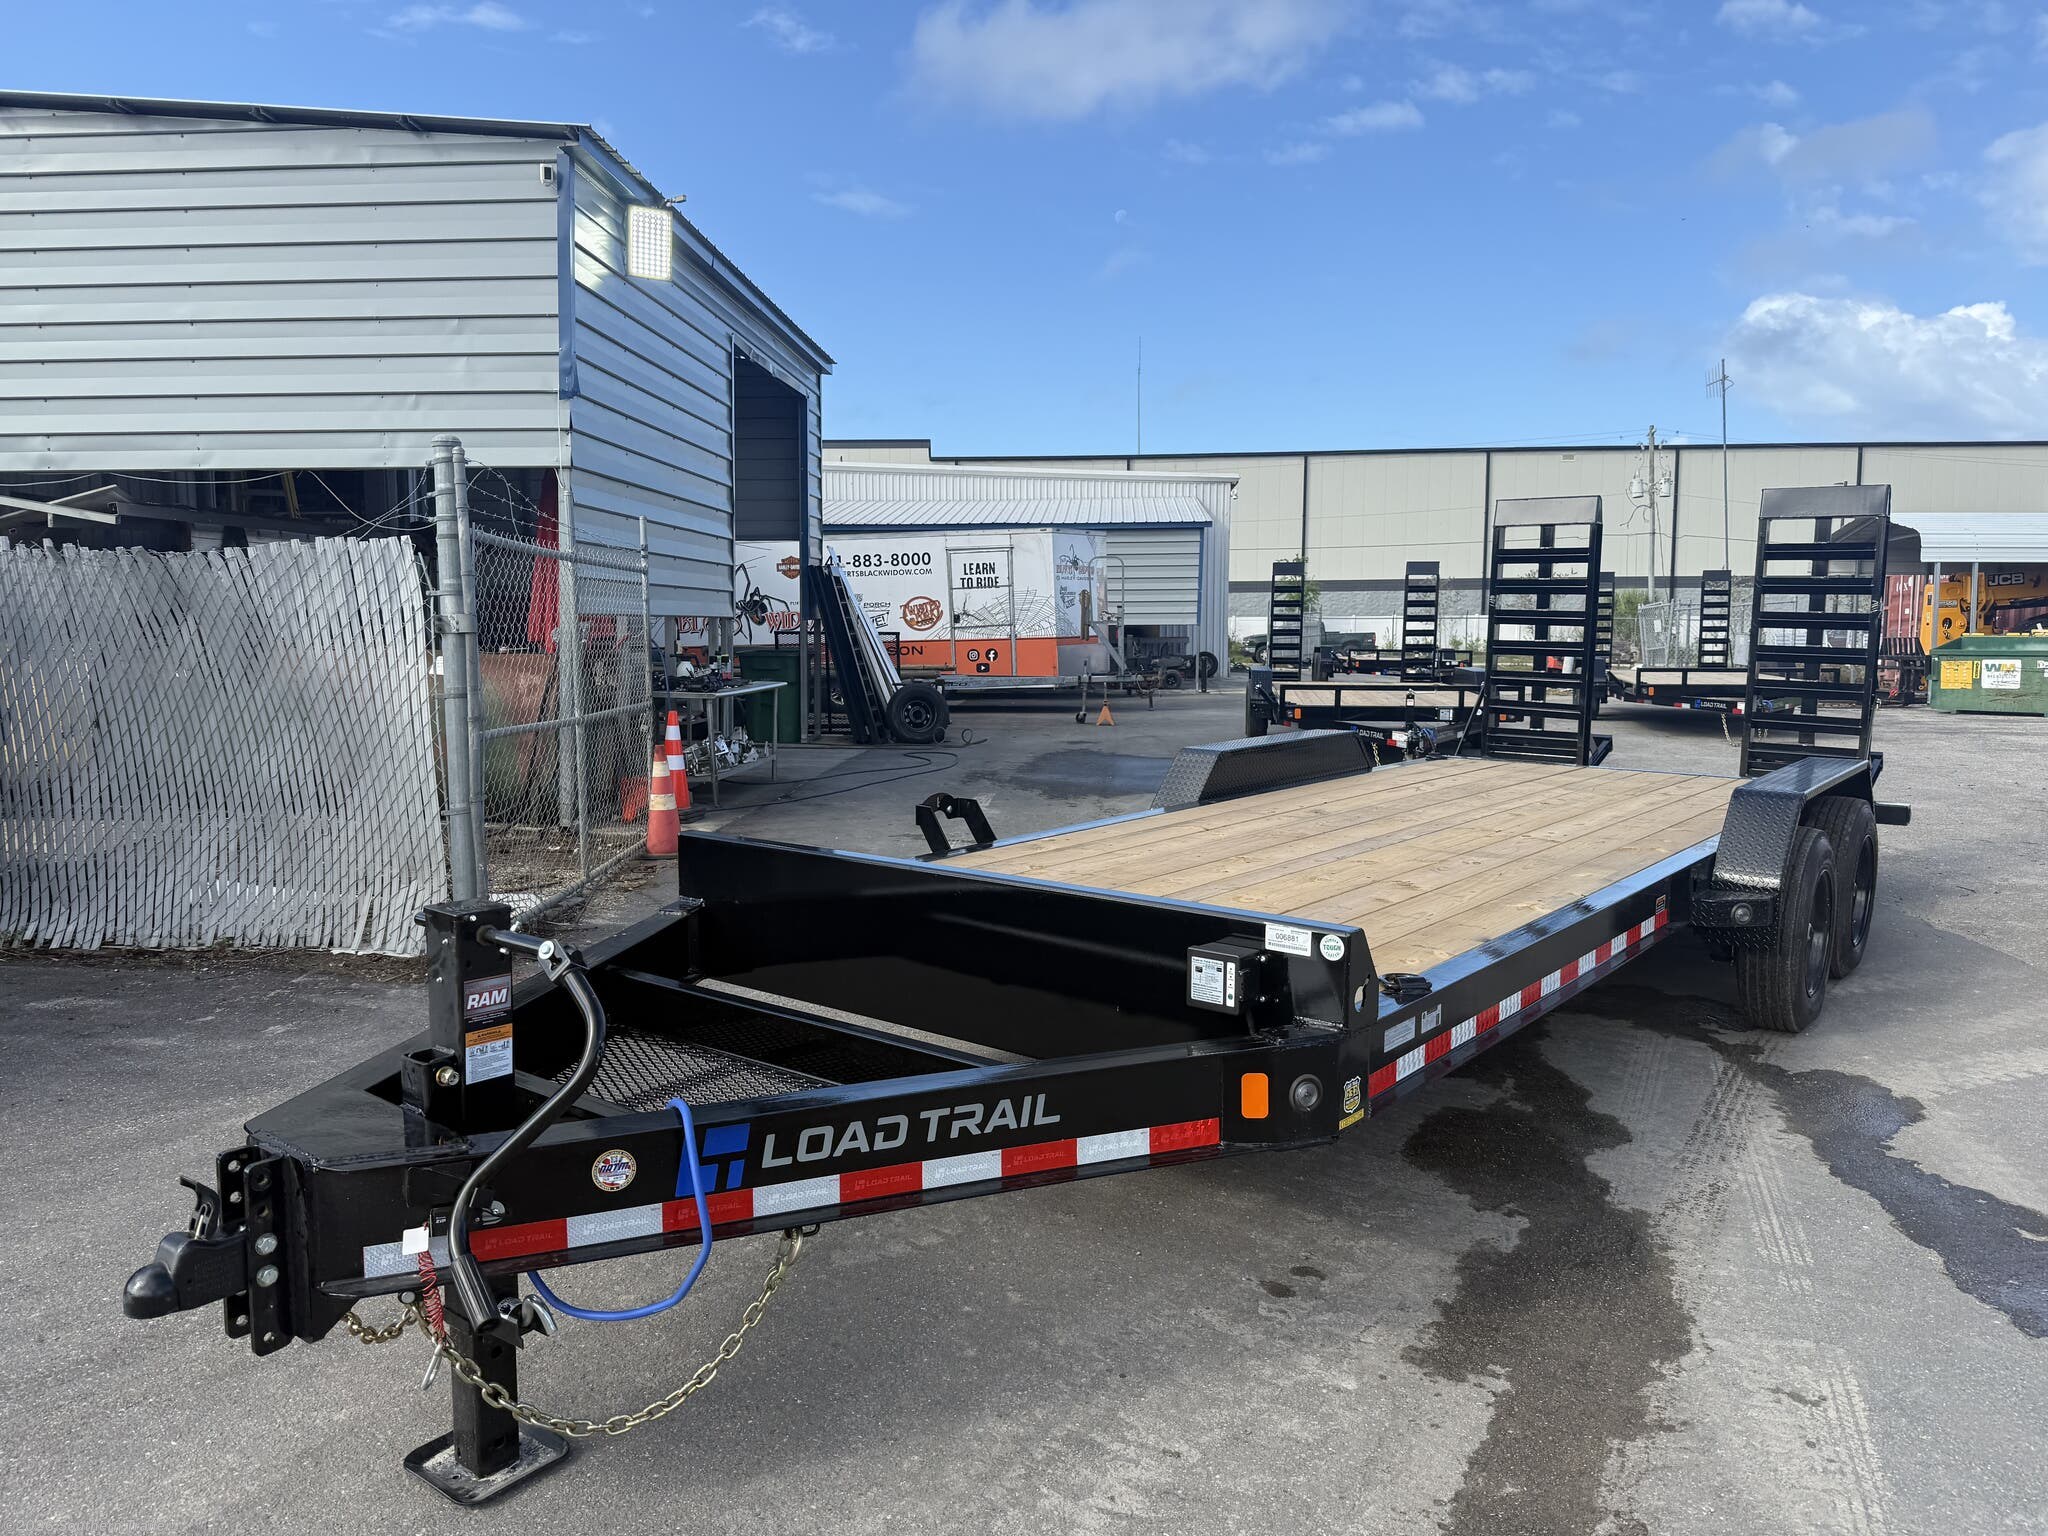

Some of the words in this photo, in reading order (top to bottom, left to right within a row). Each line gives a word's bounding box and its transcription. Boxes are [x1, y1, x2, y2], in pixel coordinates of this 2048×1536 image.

[963, 562, 996, 575] LEARN
[960, 577, 973, 589] TO
[976, 576, 1000, 588] RIDE
[1989, 573, 2024, 586] JCB
[466, 987, 509, 1011] RAM
[761, 1114, 909, 1169] LOAD
[919, 1093, 1061, 1143] TRAIL
